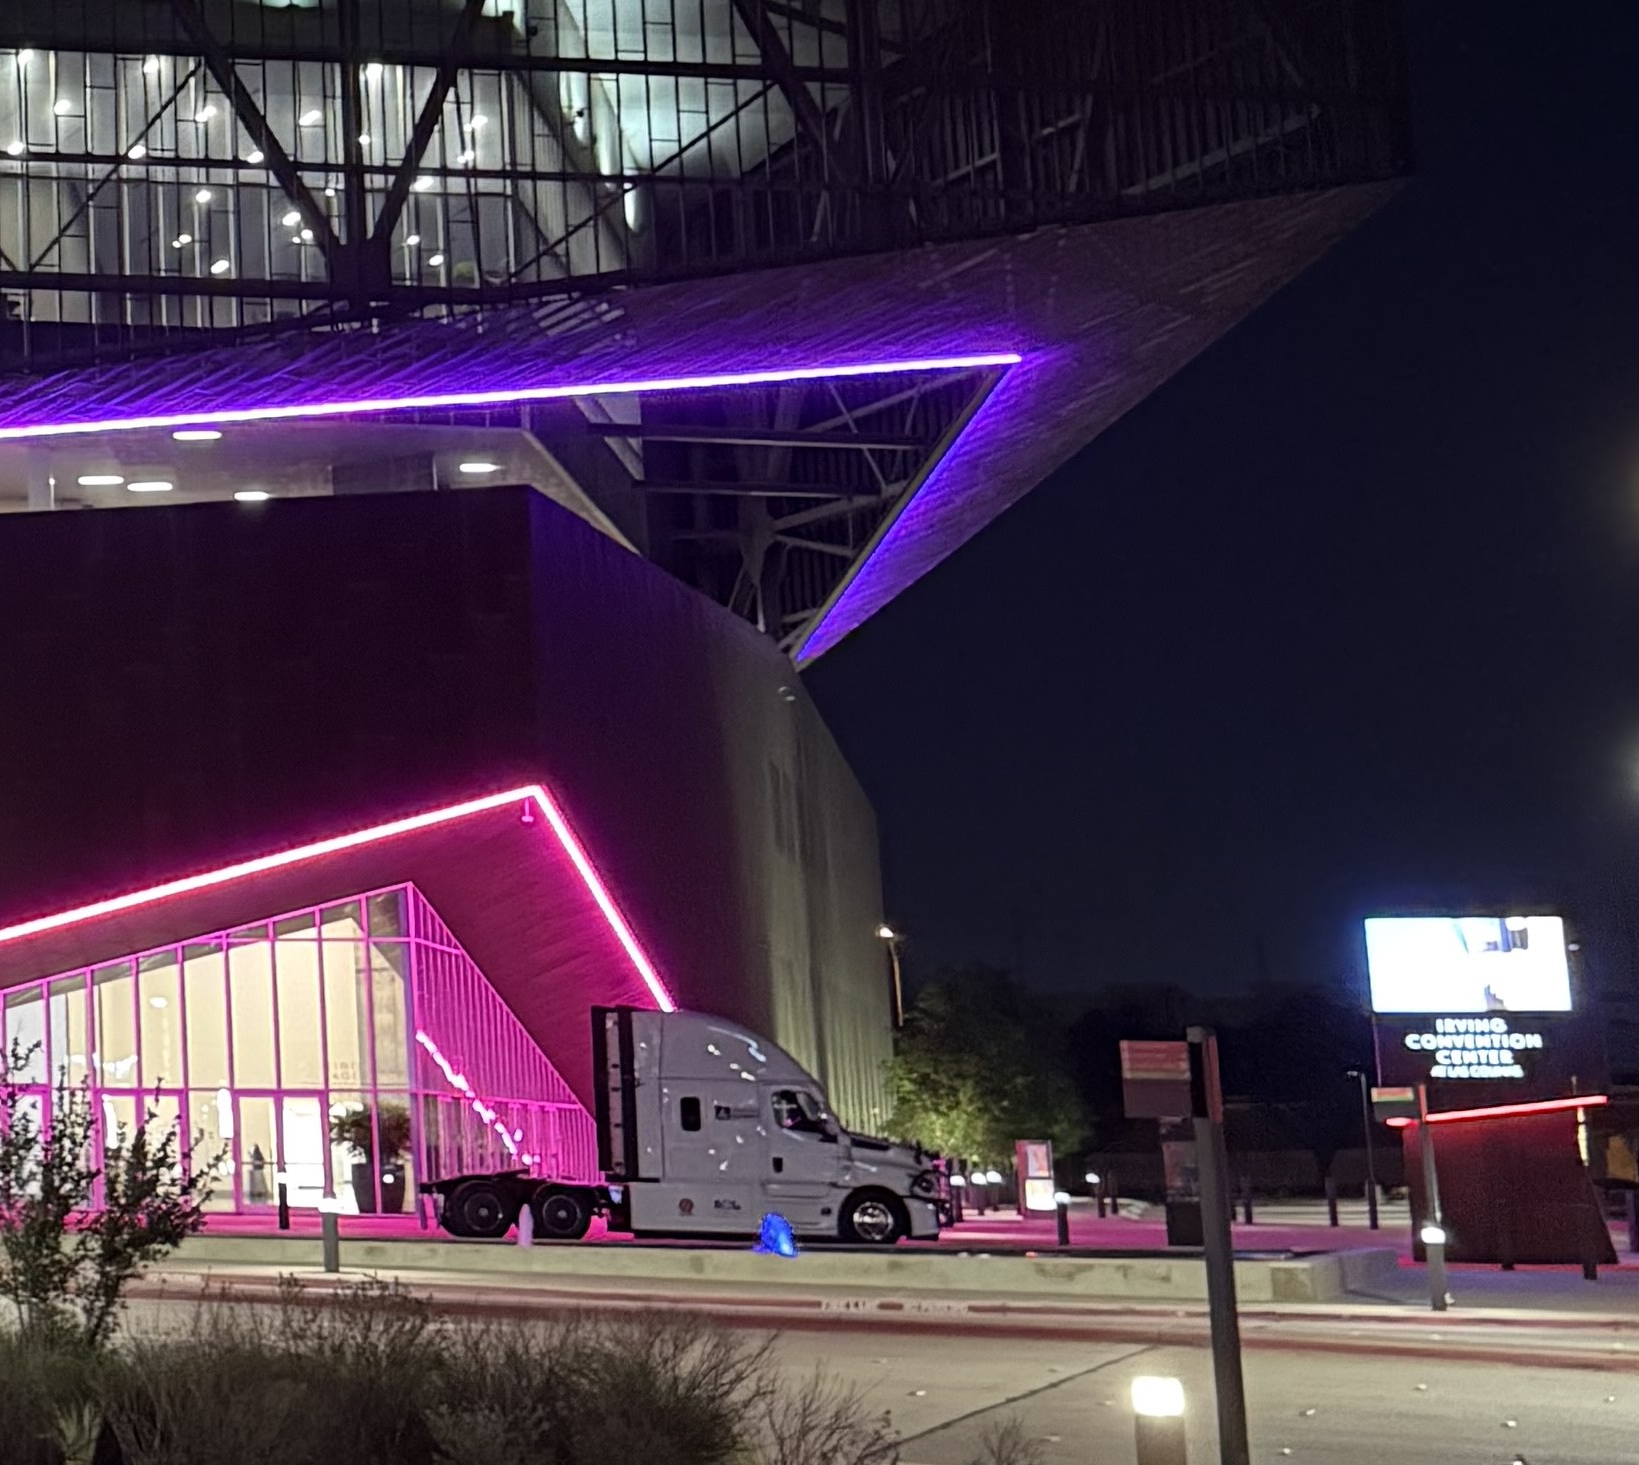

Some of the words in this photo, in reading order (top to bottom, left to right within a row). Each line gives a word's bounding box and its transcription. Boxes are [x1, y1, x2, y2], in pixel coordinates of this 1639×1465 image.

[1435, 1017, 1508, 1033] IRVING
[1405, 1033, 1543, 1050] CONVENTION
[1435, 1049, 1514, 1065] CENTER
